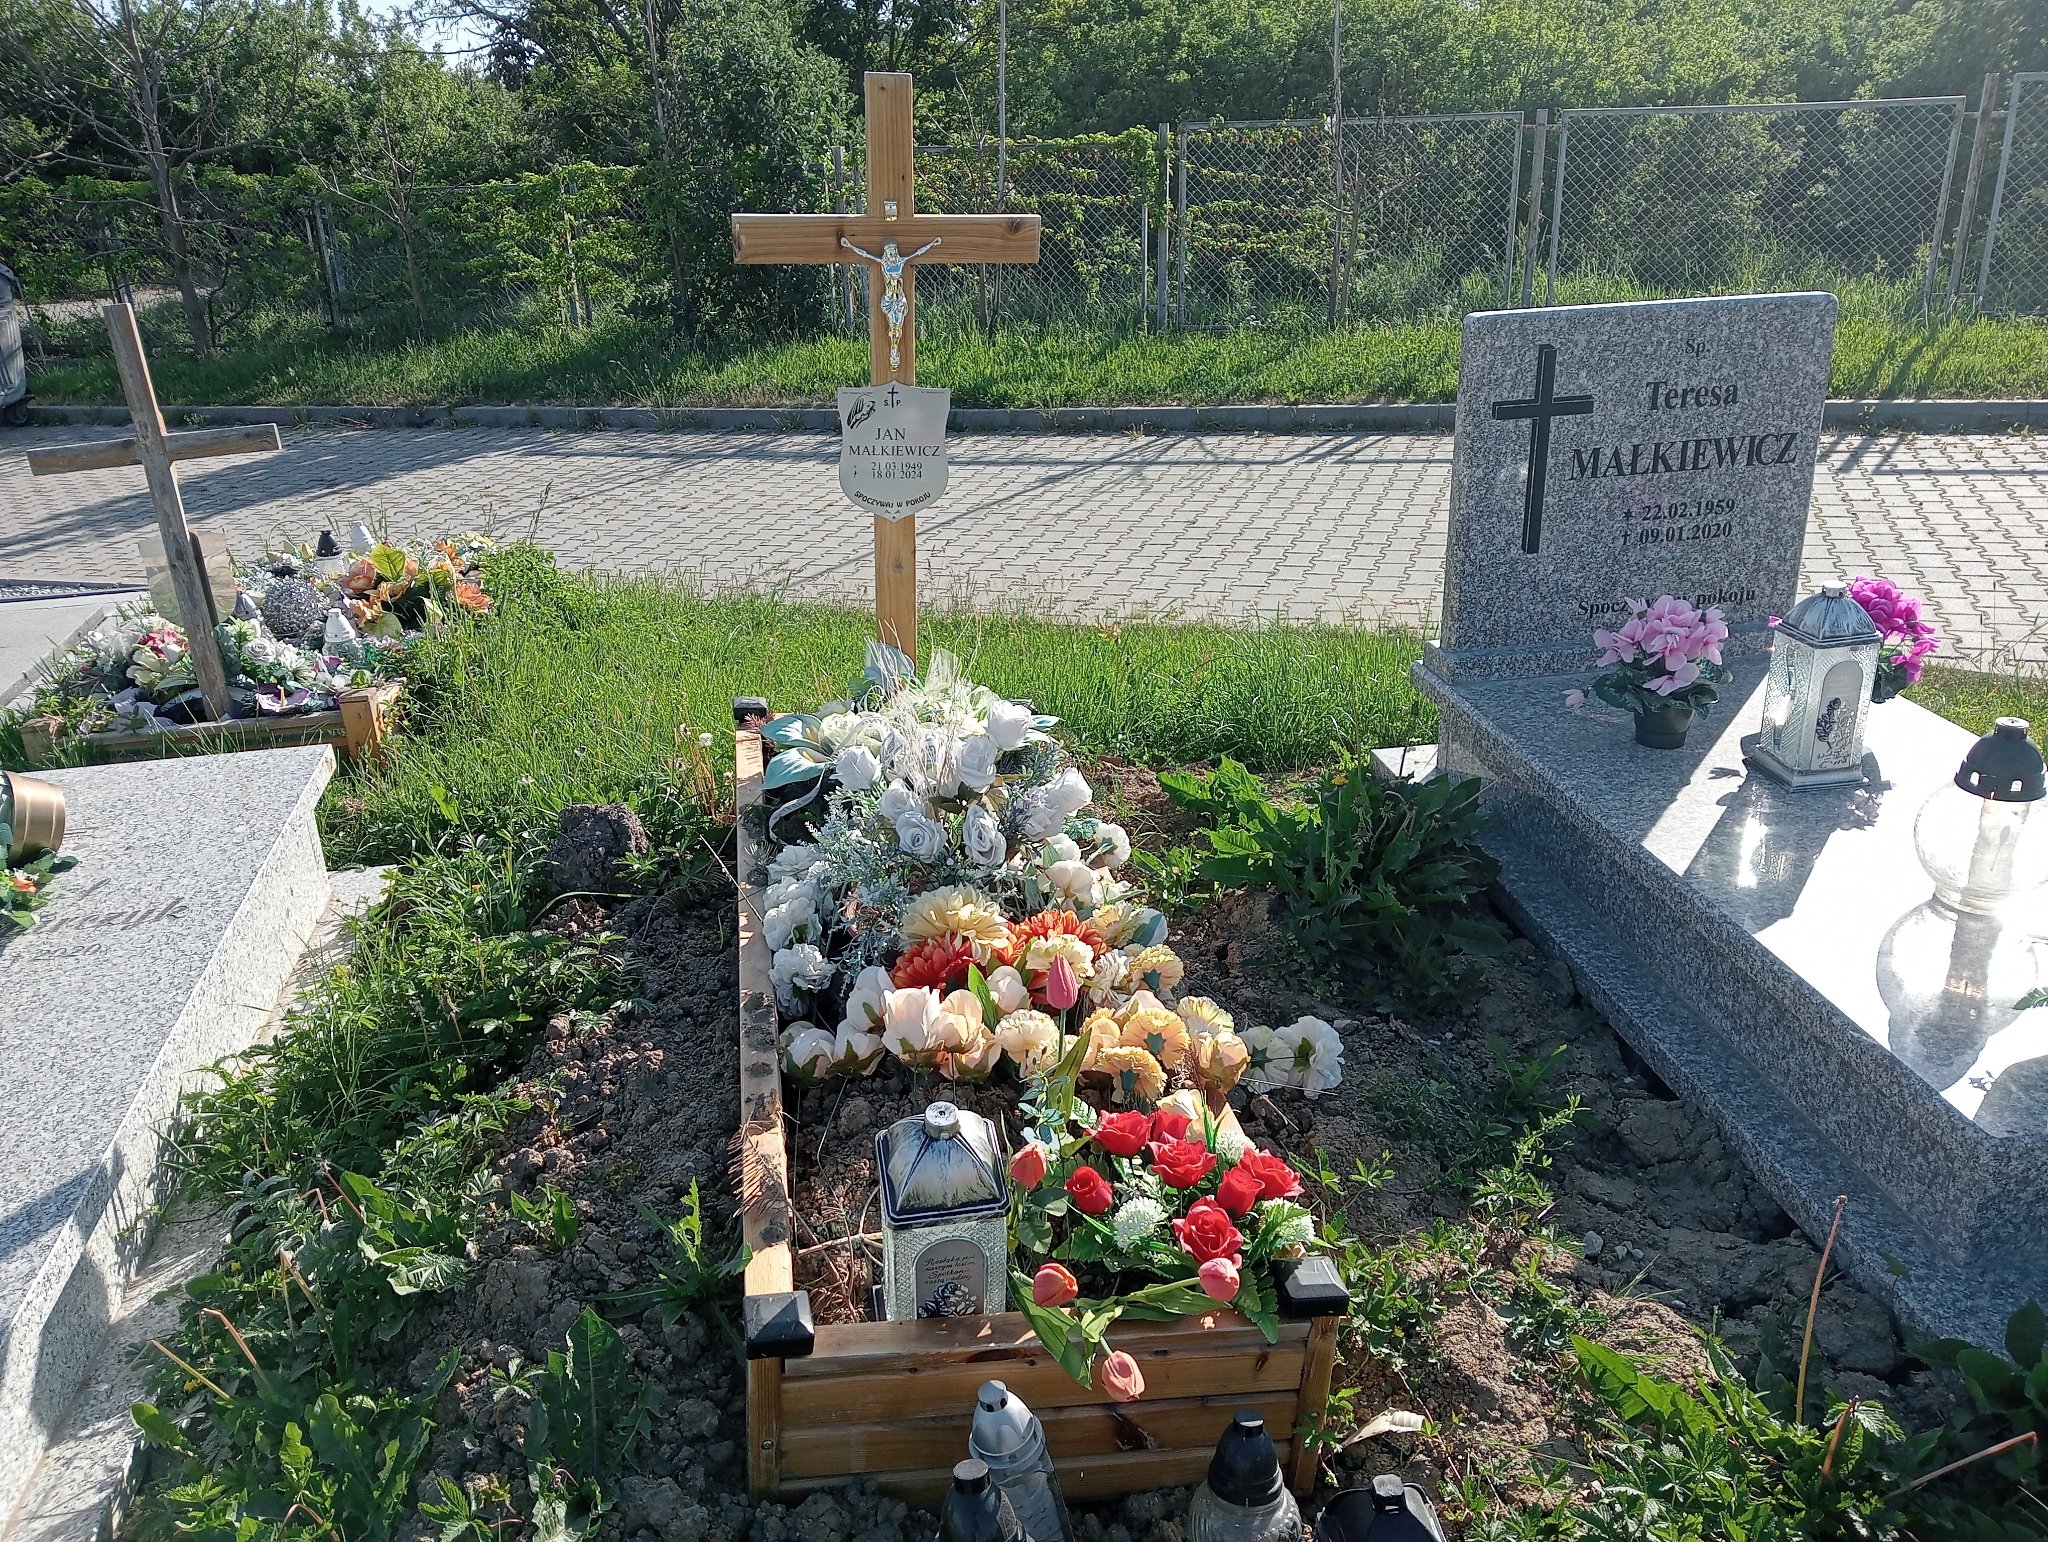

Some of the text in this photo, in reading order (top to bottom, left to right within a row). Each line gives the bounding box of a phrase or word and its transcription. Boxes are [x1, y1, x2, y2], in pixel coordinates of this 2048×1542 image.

[1646, 381, 1739, 410] Teresa
[875, 428, 906, 441] JAN
[849, 445, 941, 457] MAŁKIEWICZ
[1567, 432, 1799, 481] MAŁKIEWICZ
[871, 461, 923, 471] 21.03.1949
[872, 470, 922, 479] 18.01.2024
[854, 490, 894, 508] SPOCZYWAJ
[905, 491, 931, 507] POKOJU
[1641, 500, 1736, 522] 22.02.1959
[1638, 522, 1733, 544] 09.01.2020
[1695, 587, 1756, 609] pokoju
